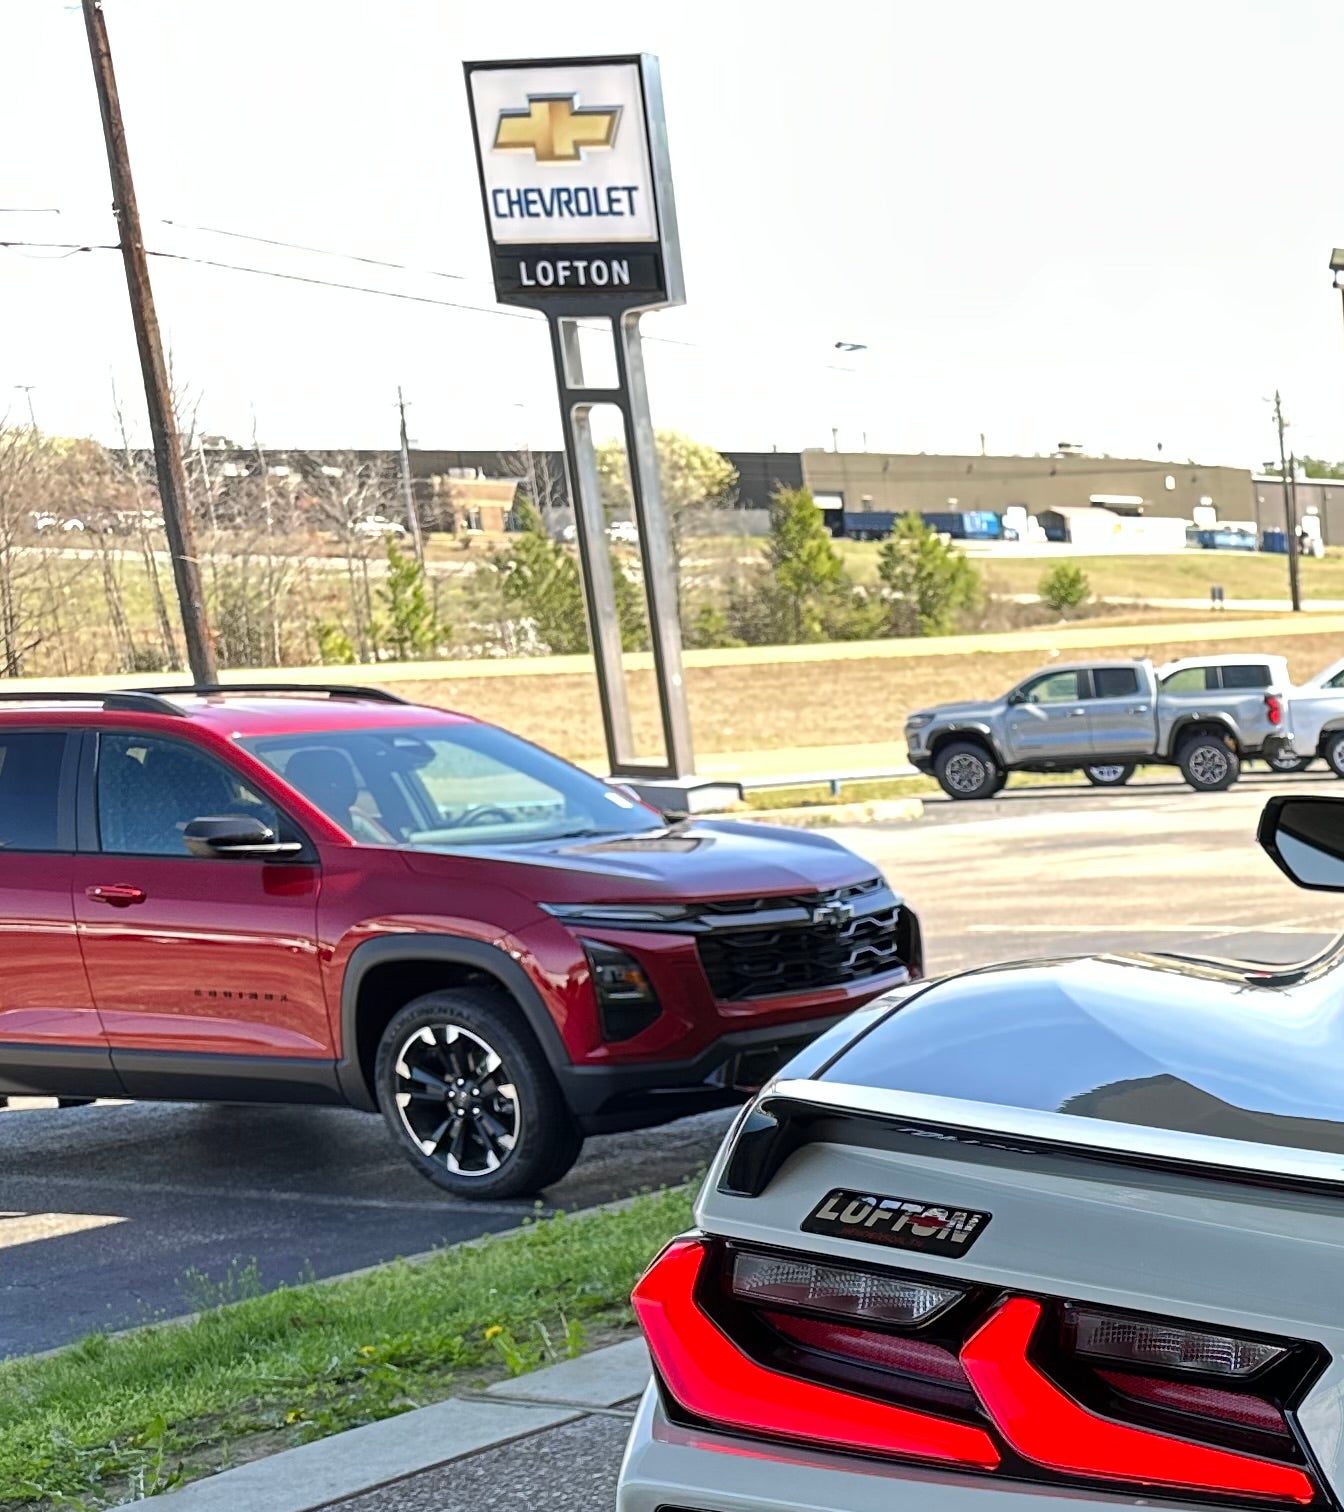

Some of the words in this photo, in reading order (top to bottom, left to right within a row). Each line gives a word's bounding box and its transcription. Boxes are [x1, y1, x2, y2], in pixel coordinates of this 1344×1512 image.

[492, 186, 638, 219] CHEVROLET
[519, 260, 631, 287] LOFTON
[815, 1191, 983, 1244] LOFTON
